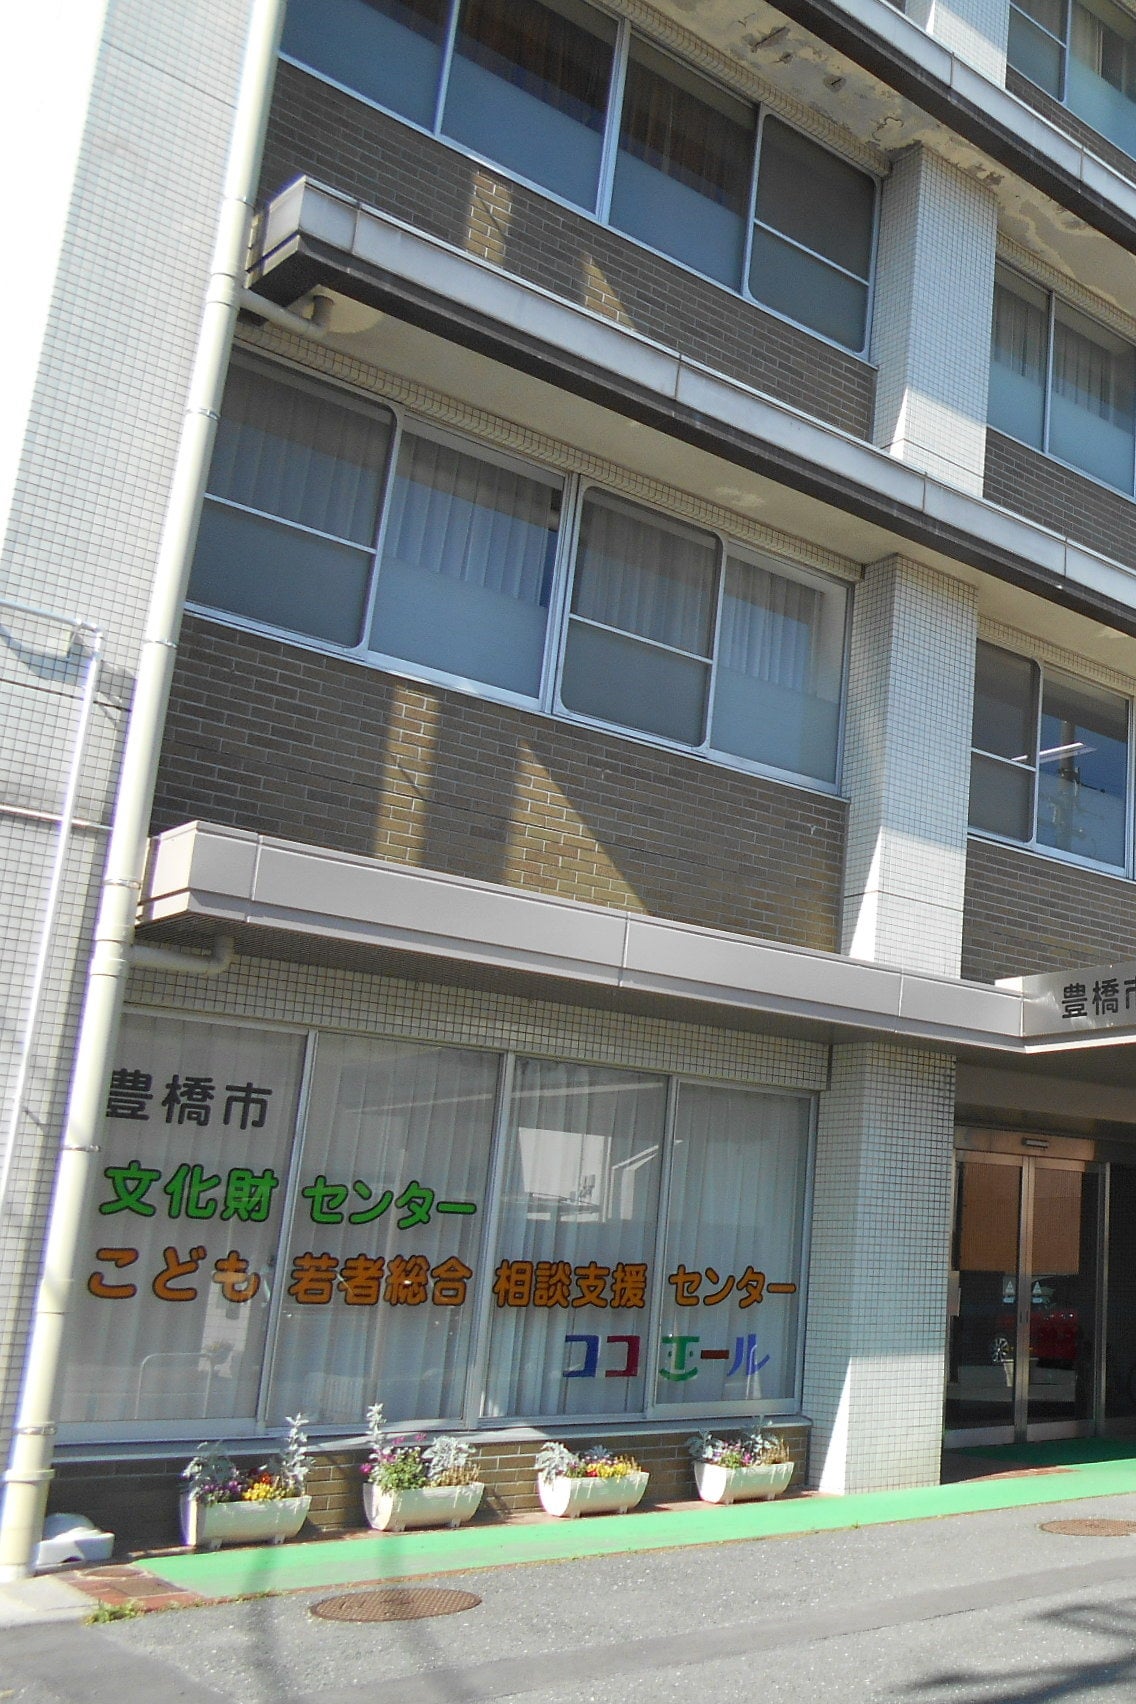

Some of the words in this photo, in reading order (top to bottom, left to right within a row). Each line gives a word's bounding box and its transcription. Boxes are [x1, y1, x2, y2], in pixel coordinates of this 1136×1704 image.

[106, 1067, 273, 1130] 豊橋市
[99, 1160, 279, 1223] 文化財
[301, 1174, 477, 1229] センター
